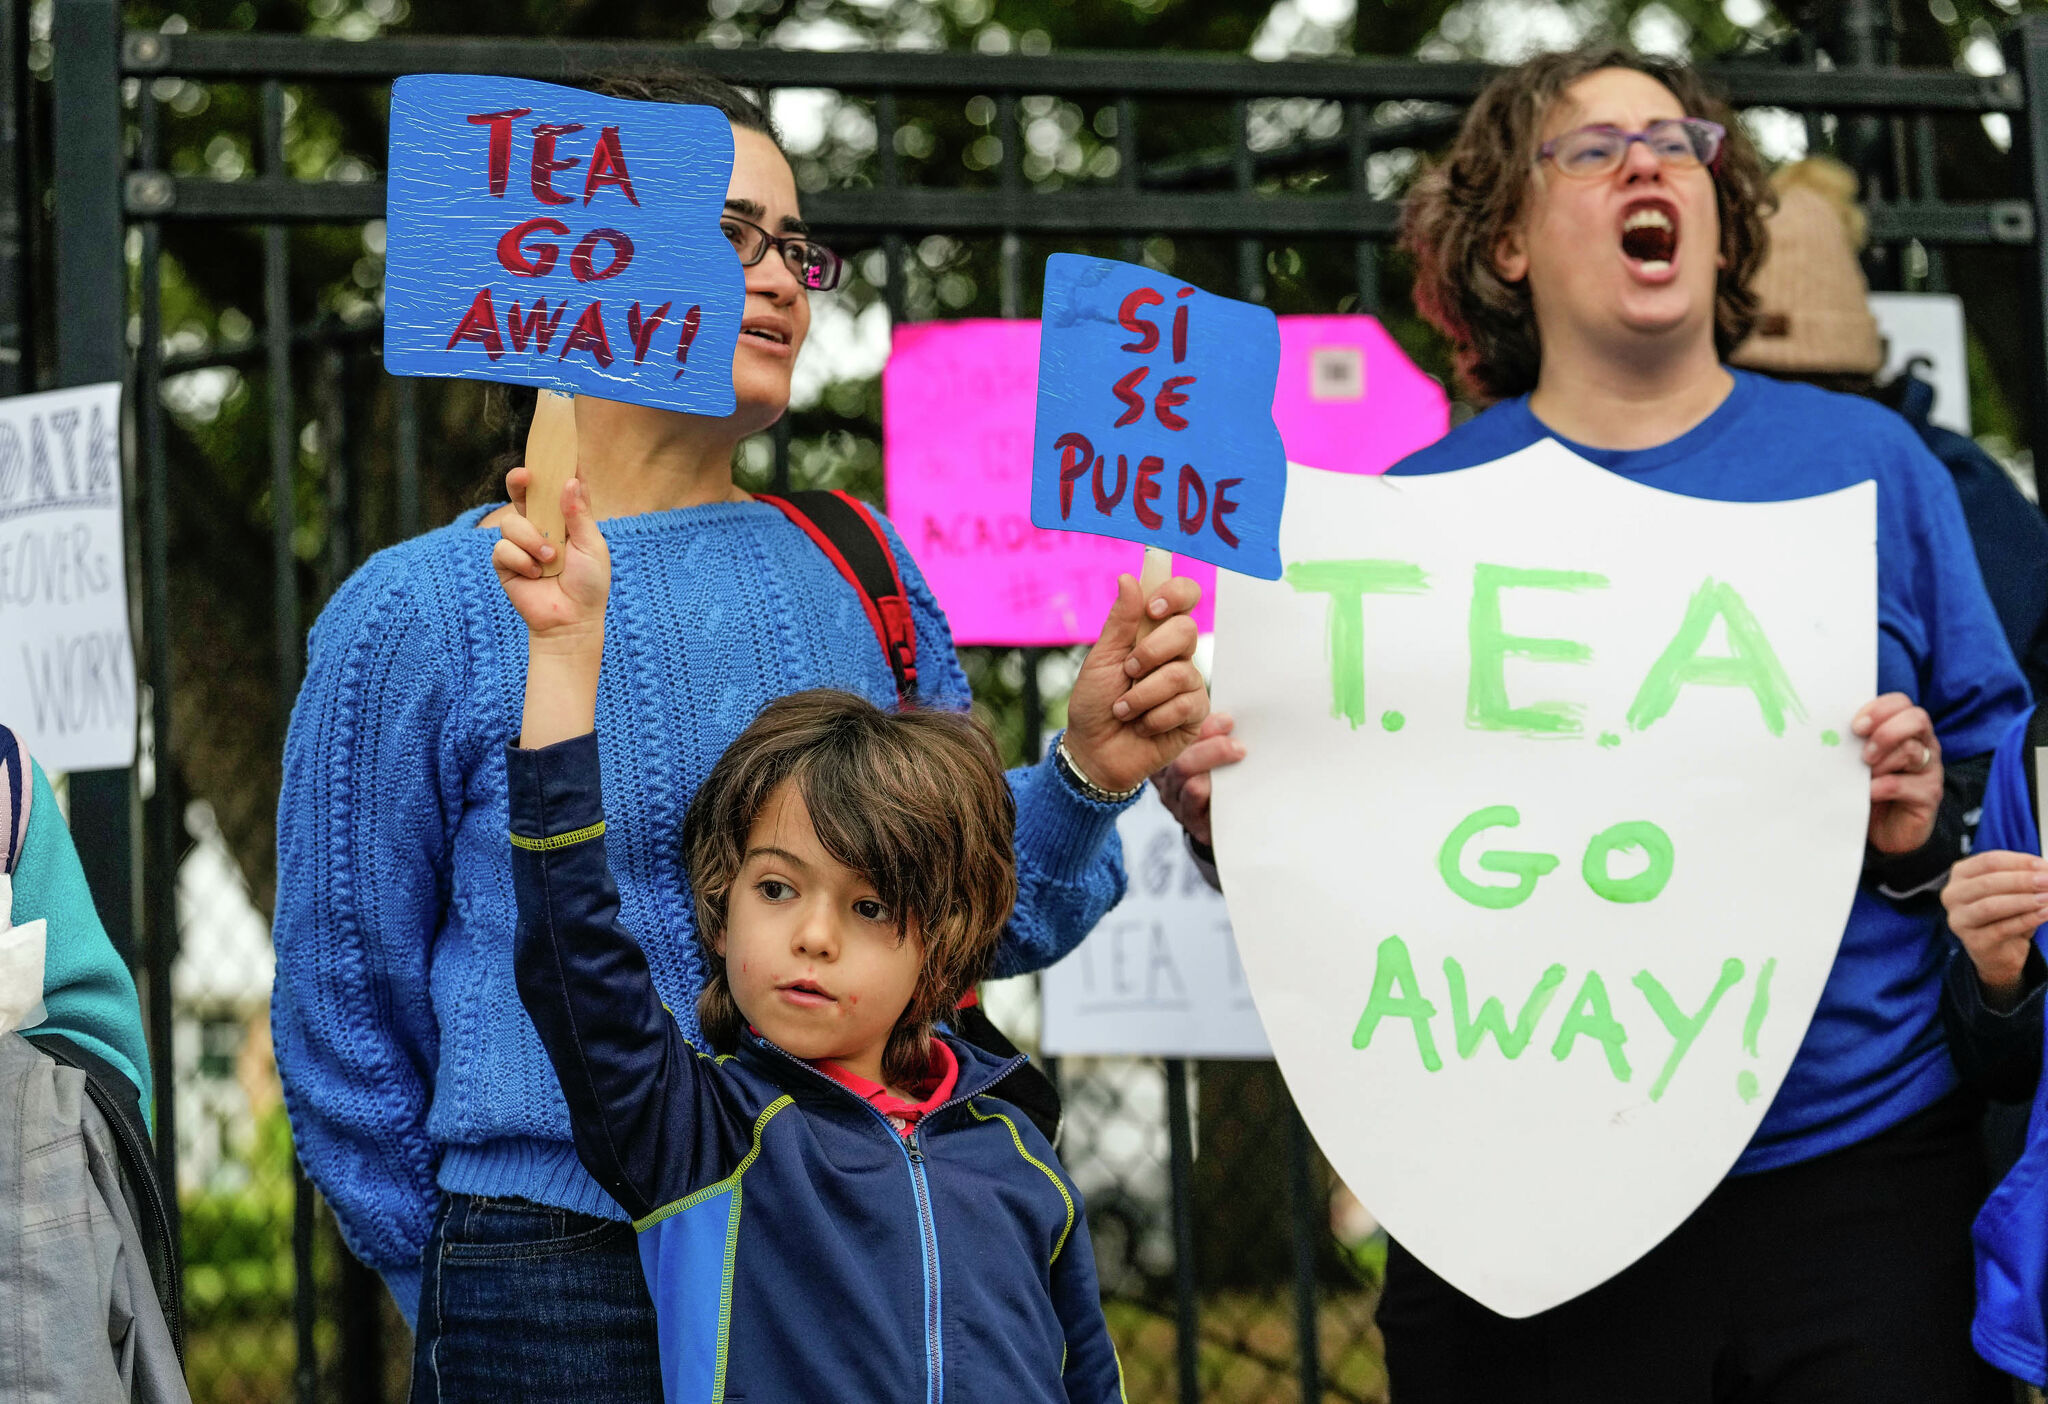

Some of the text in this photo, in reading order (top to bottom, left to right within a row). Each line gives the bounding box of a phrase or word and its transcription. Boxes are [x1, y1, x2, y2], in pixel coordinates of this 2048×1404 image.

[466, 108, 640, 208] TEA
[496, 217, 635, 283] GO
[446, 288, 701, 380] AWAY!
[1112, 365, 1198, 431] SE
[1052, 432, 1246, 550] PUEDE
[1434, 804, 1676, 911] GO
[1350, 933, 1778, 1106] AWAY!
